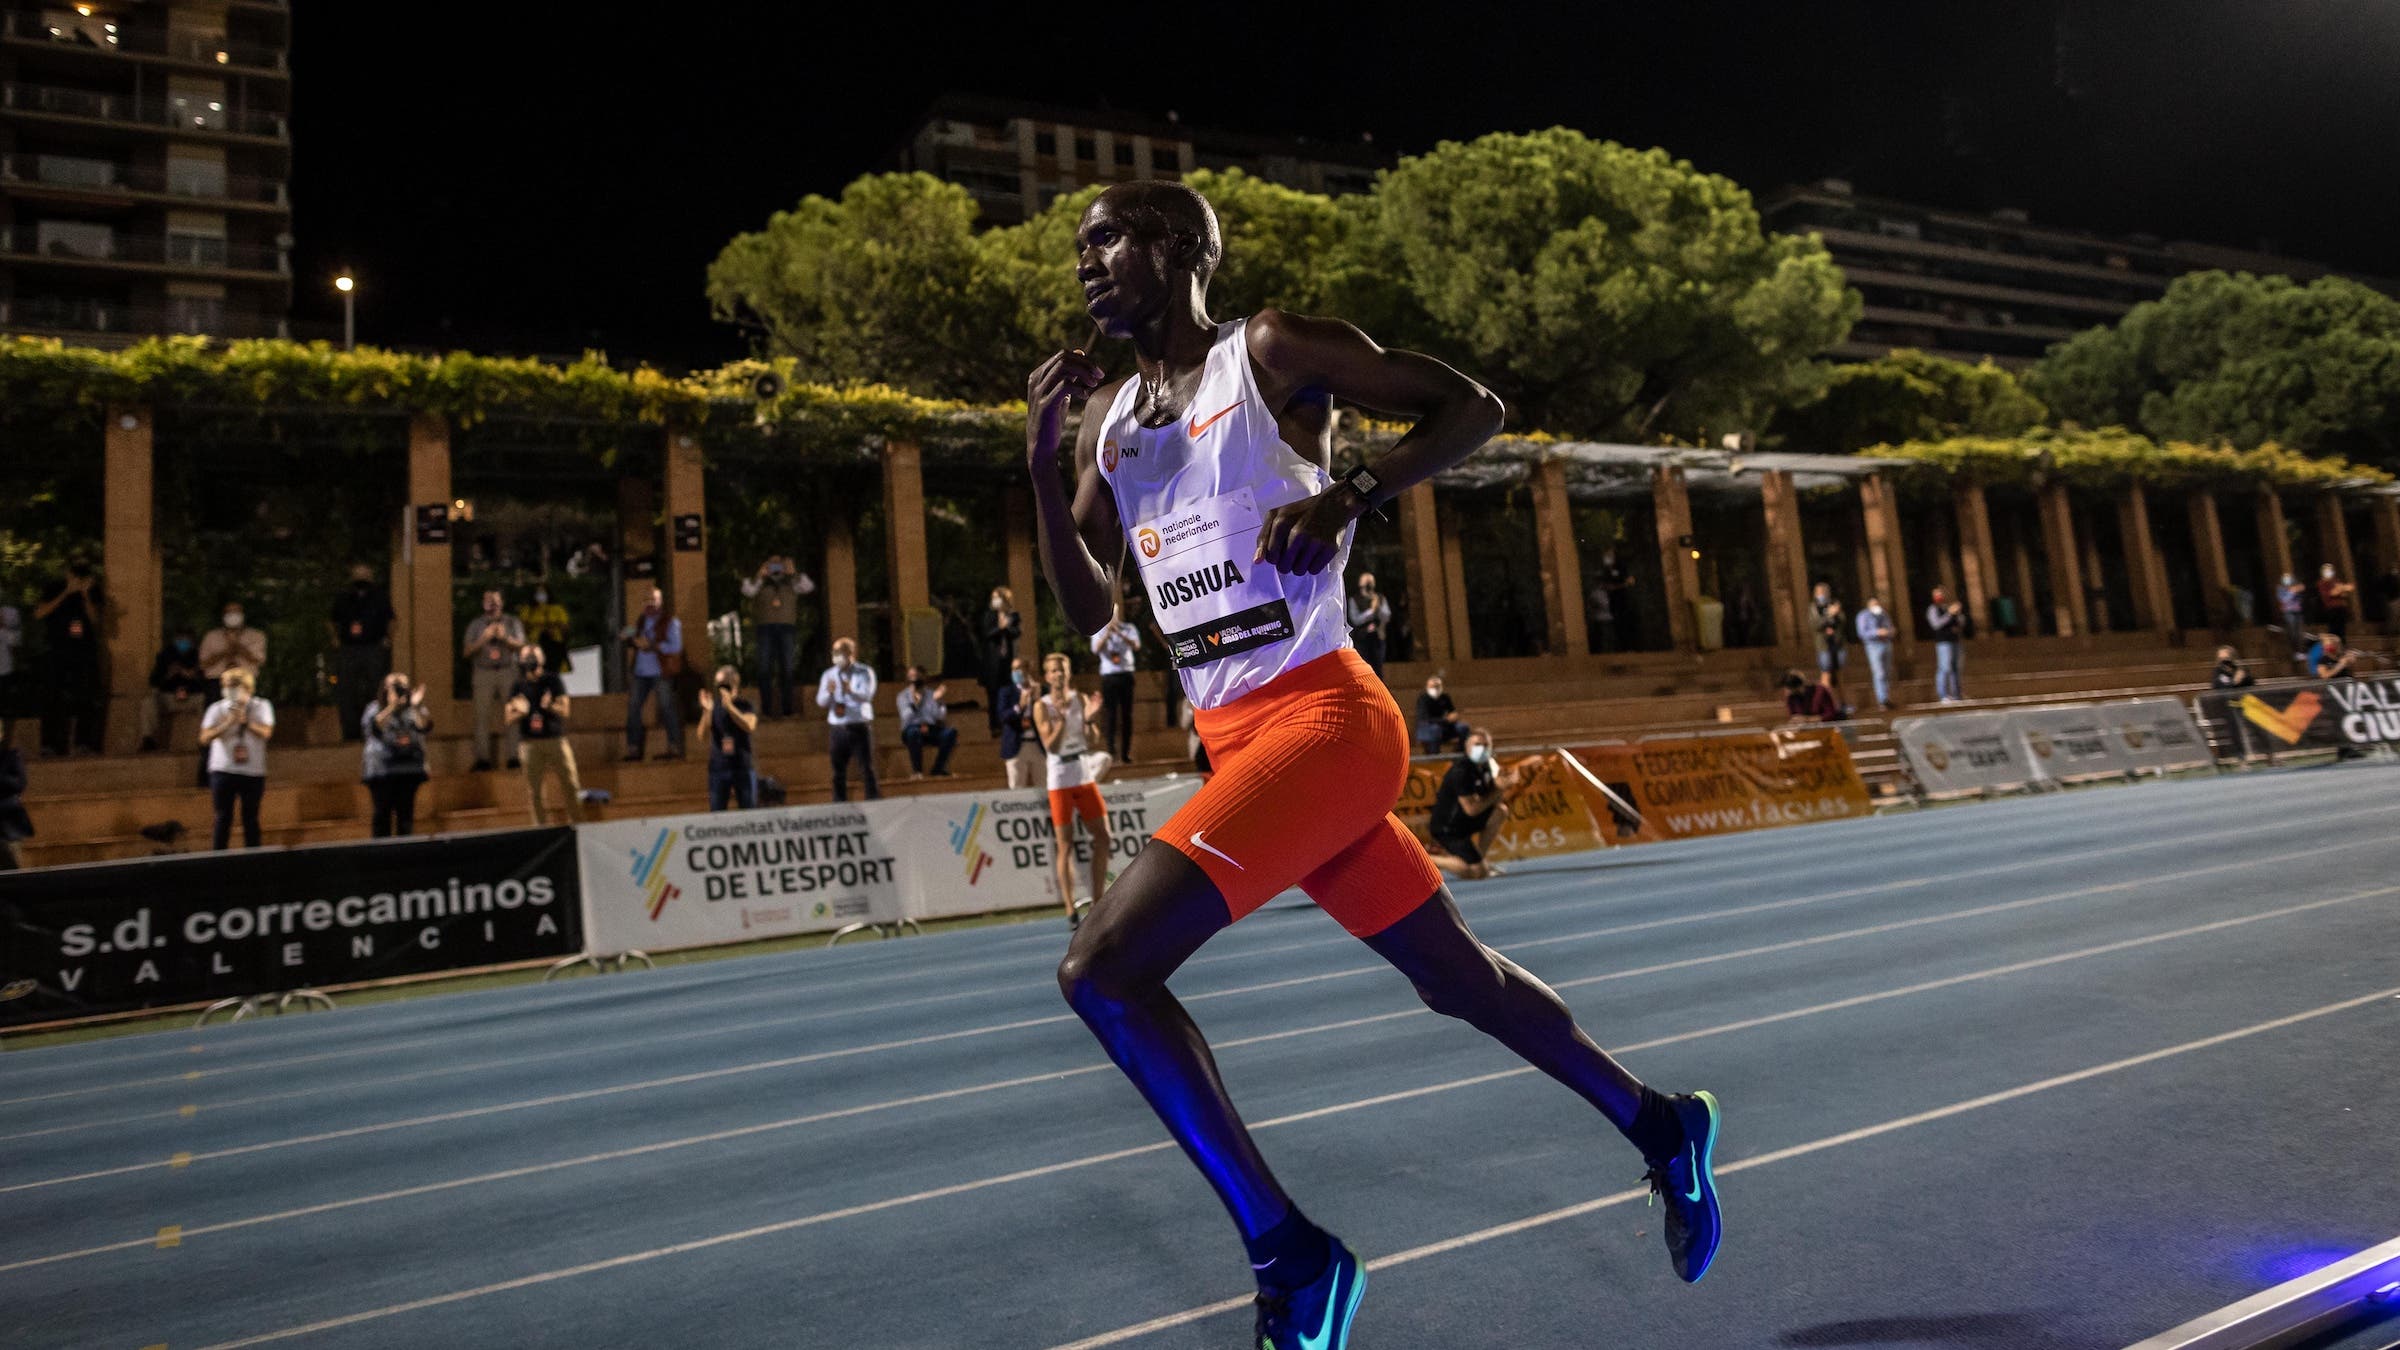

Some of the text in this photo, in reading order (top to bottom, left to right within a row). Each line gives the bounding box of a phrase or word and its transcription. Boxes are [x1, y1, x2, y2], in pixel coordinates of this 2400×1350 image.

[1121, 448, 1138, 458] NN
[1162, 513, 1201, 535] nationale
[1165, 519, 1219, 546] nederlanden
[1156, 559, 1244, 610] JOSHUA
[1239, 630, 1252, 640] DEL
[1251, 620, 1281, 636] RUNNING
[2327, 680, 2400, 712] VAL
[684, 810, 867, 842] Comunitat Valenciana
[688, 831, 870, 873] COMUNITAT
[1013, 844, 1048, 868] DE
[706, 857, 896, 901] DE L'ESPORT
[61, 876, 555, 957] s.d. correcaminos
